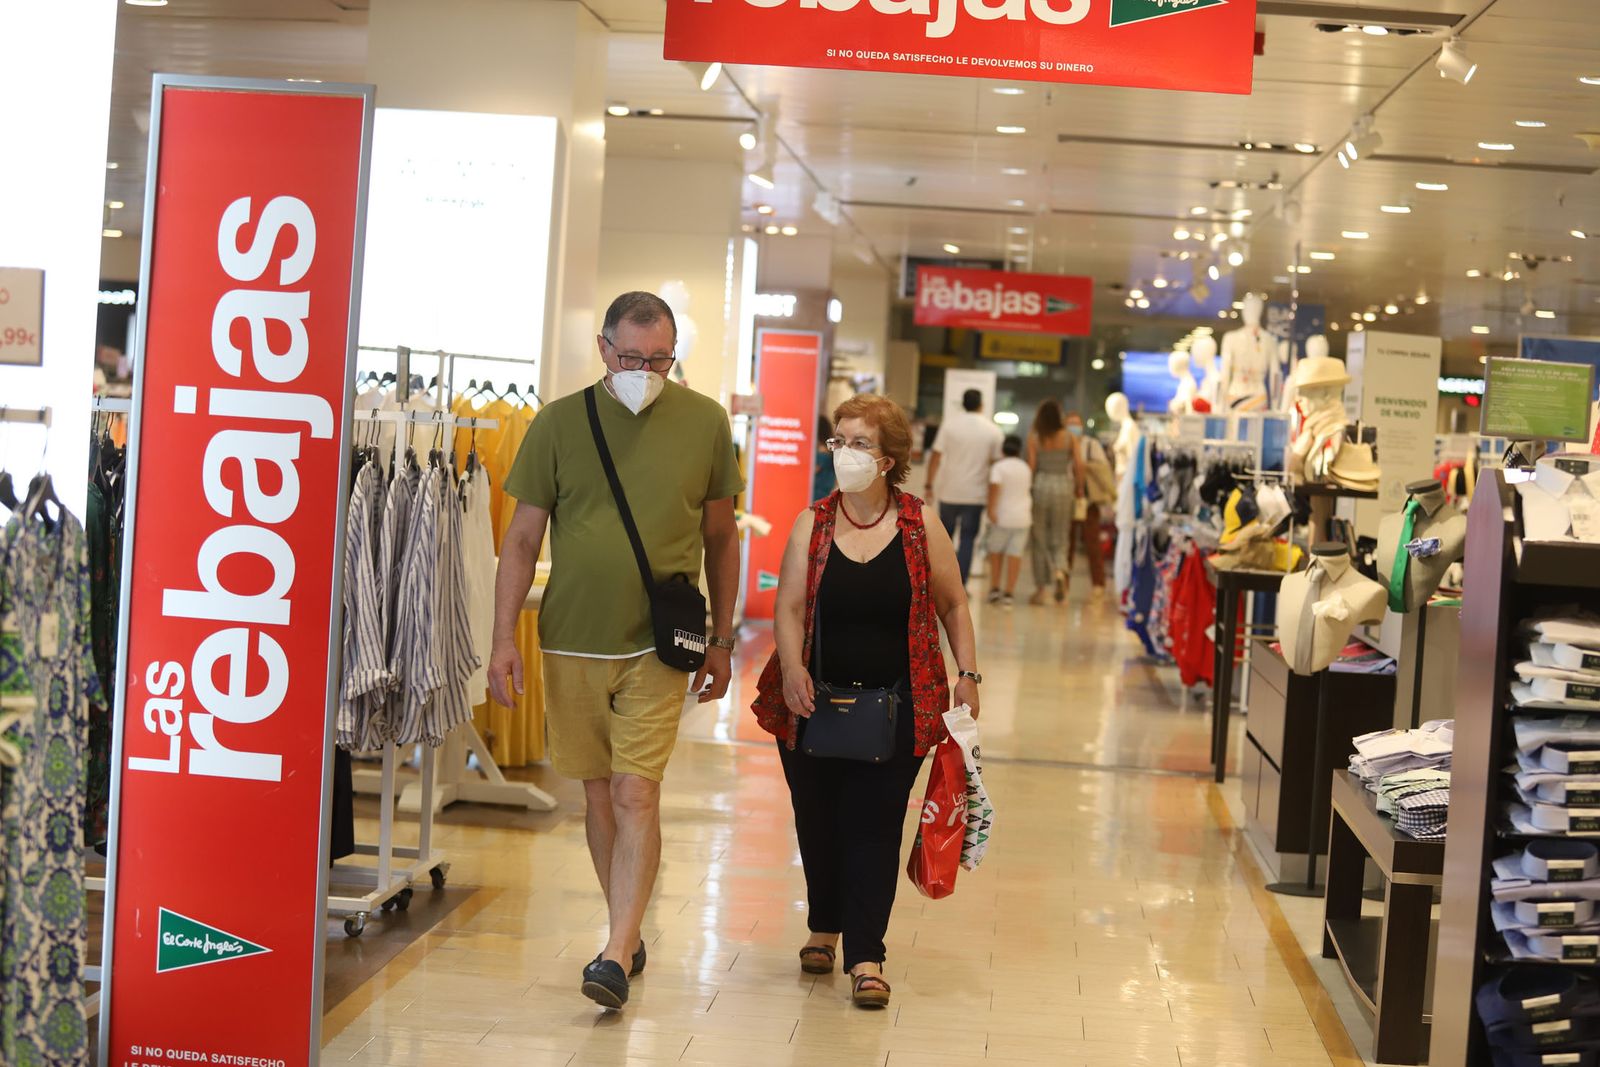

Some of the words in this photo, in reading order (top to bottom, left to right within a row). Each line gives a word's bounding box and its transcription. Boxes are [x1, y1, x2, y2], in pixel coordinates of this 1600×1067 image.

[826, 48, 836, 57] SI
[838, 50, 853, 58] NO
[856, 50, 890, 60] QUEDA
[892, 52, 954, 64] SATISFECHO
[956, 56, 968, 65] LE
[971, 57, 1037, 69] DEVOLVEMOS
[1039, 61, 1053, 70] SU
[1056, 63, 1093, 73] DINERO
[921, 280, 1041, 319] rebajas
[1394, 410, 1421, 419] NUEVO
[162, 194, 335, 783] rebajas
[128, 659, 186, 774] Las
[163, 931, 175, 946] El
[175, 934, 203, 948] Corte
[203, 933, 243, 955] Inglés
[130, 1045, 142, 1056] SI
[146, 1046, 162, 1058] NO
[166, 1049, 208, 1062] QUEDA
[211, 1053, 286, 1067] SATISFECHO
